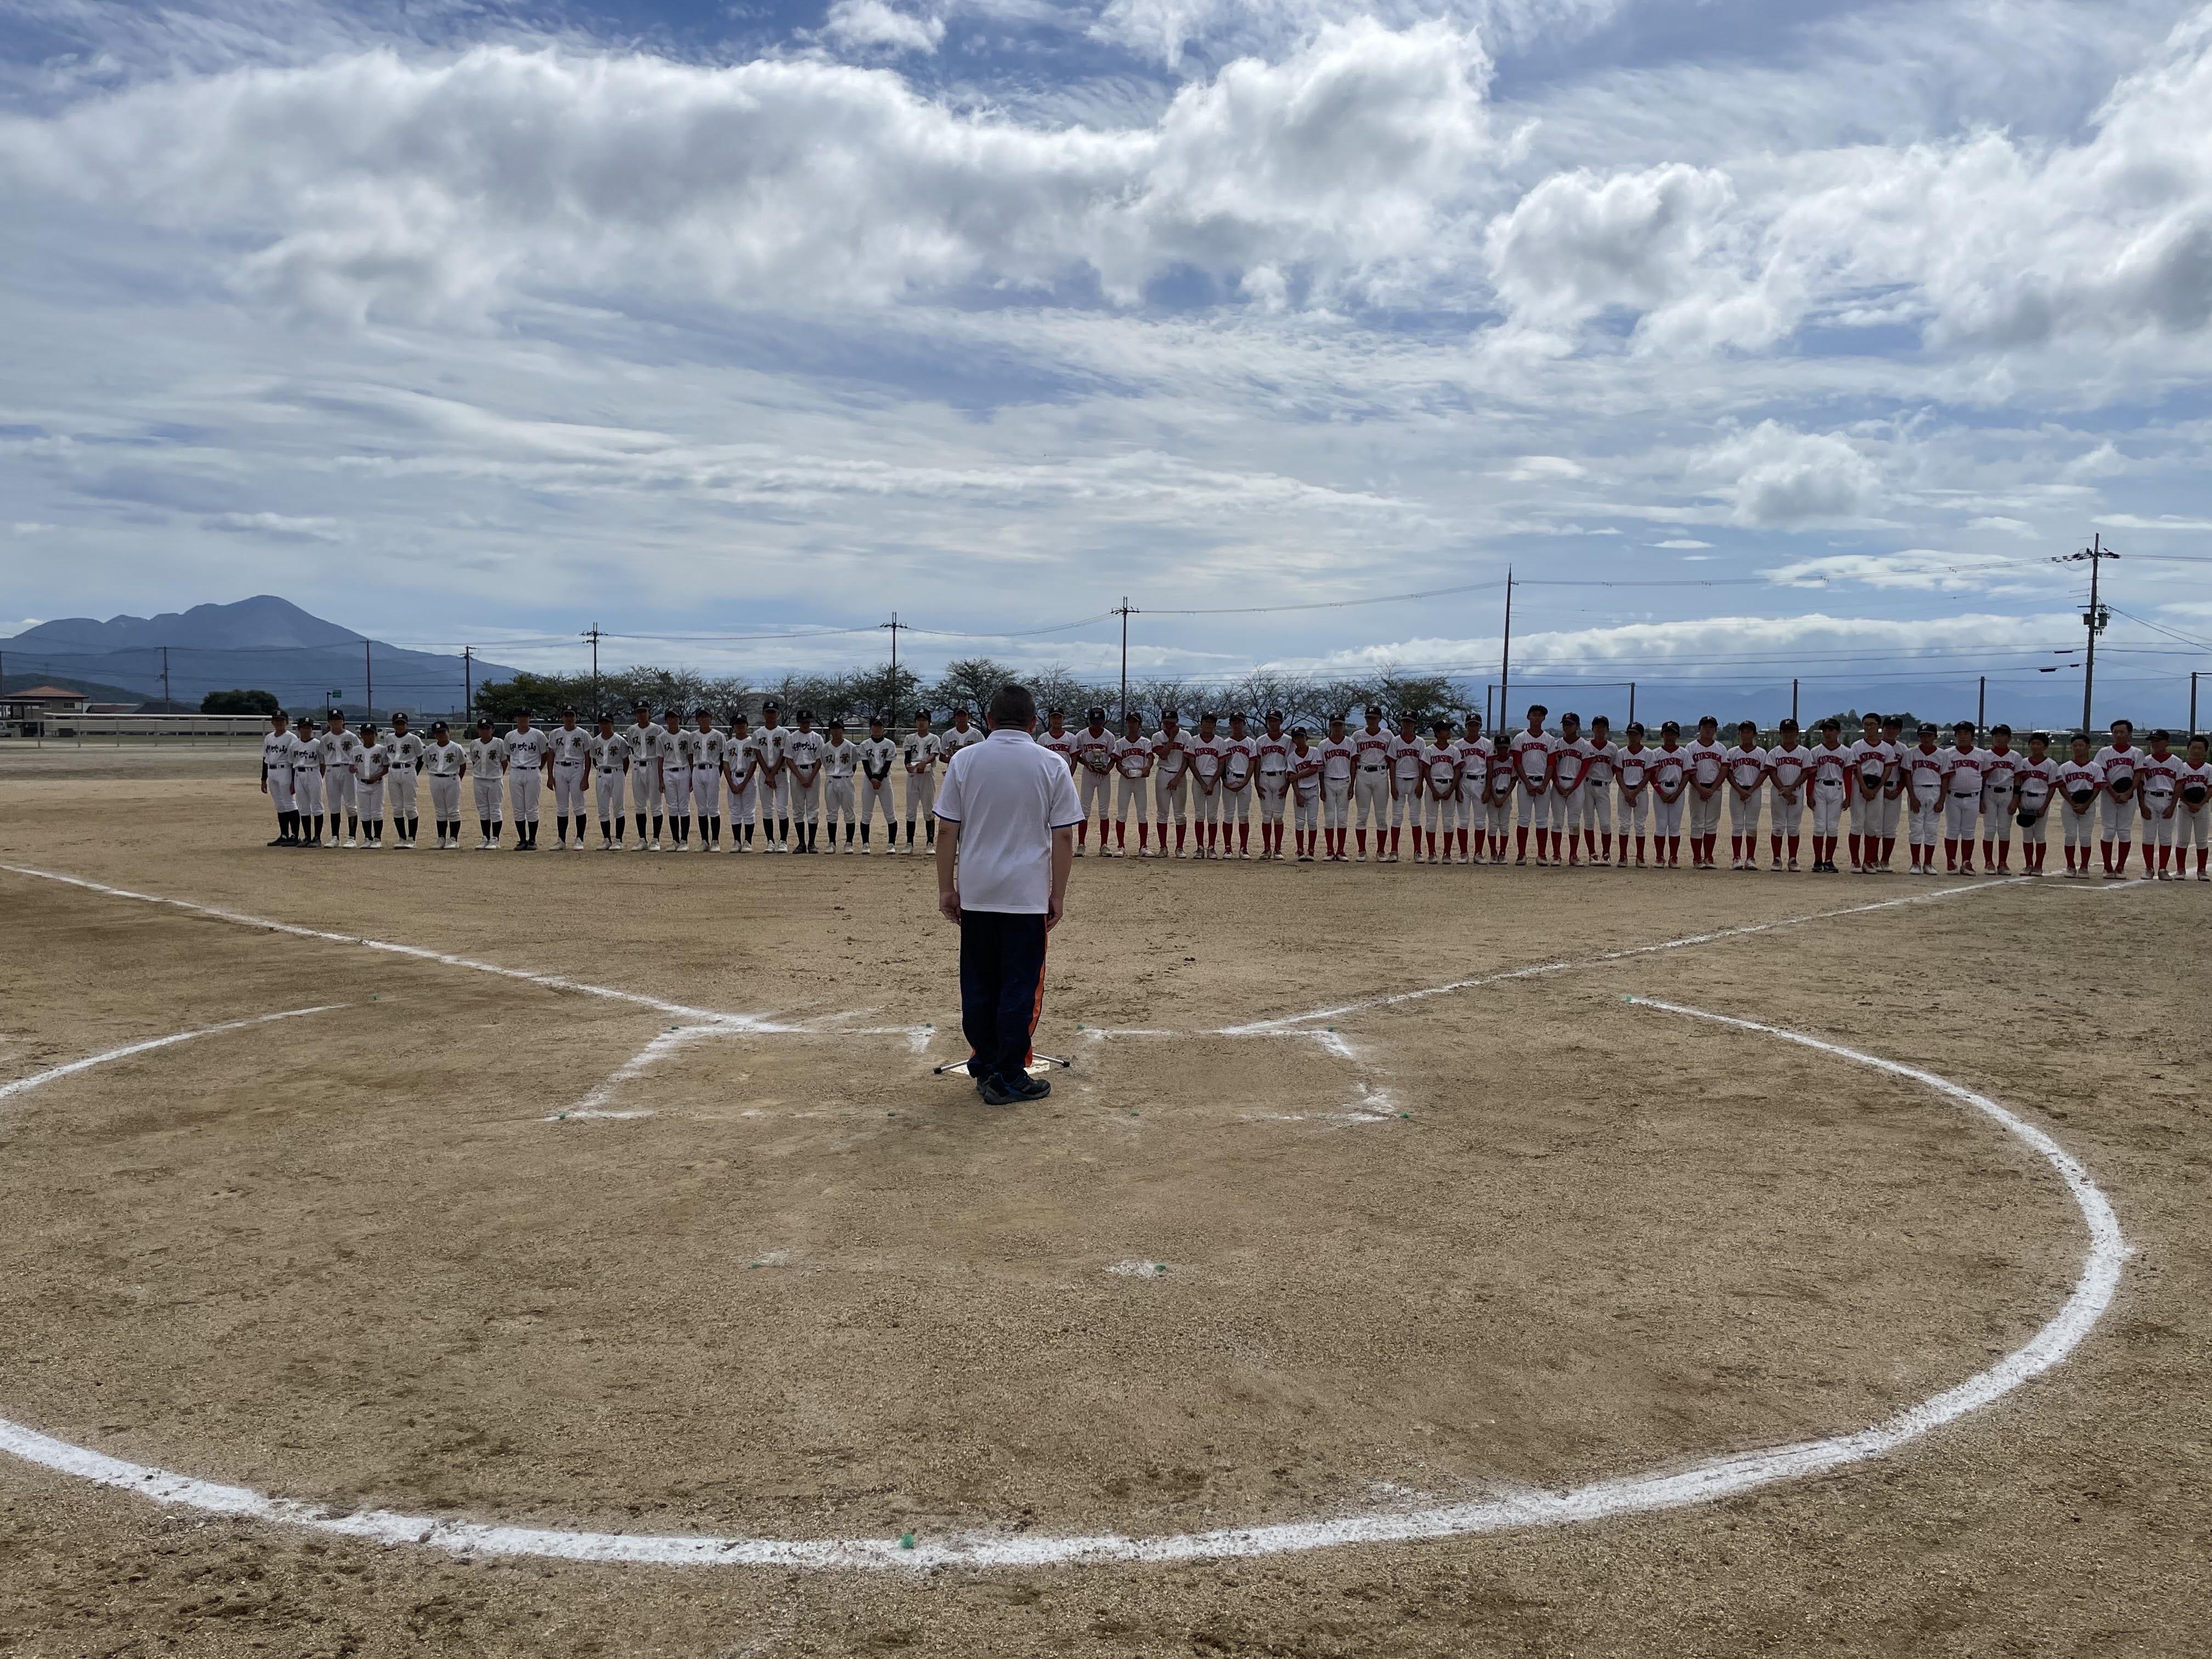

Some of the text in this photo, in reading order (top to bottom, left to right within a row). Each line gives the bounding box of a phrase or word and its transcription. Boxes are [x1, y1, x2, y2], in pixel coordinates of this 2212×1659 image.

[792, 742, 817, 753] 伊吹山
[825, 753, 850, 764] 双葉
